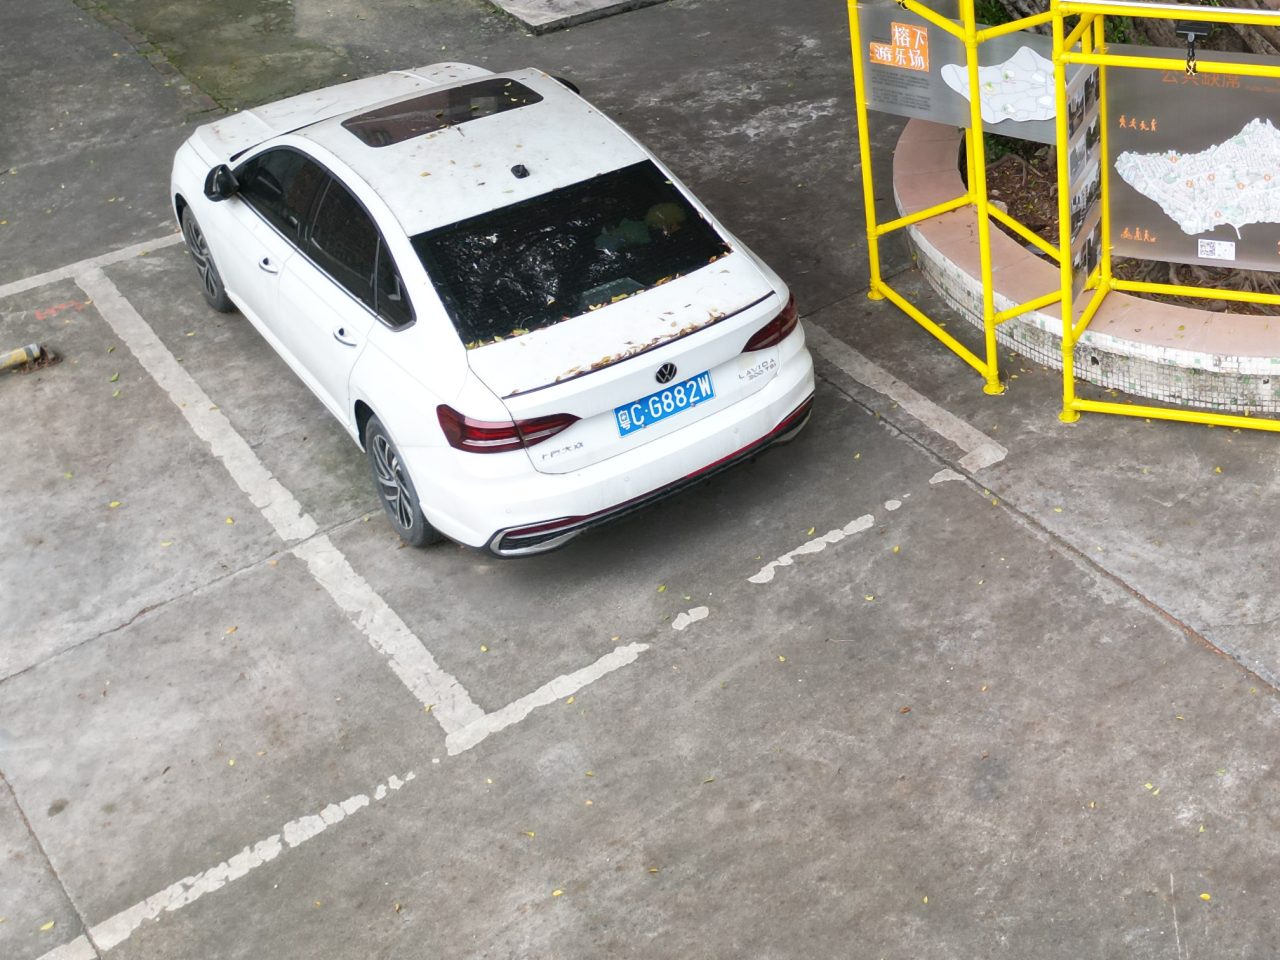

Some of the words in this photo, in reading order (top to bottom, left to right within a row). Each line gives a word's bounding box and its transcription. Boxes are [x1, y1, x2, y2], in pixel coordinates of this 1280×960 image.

[894, 25, 927, 49] 榕下
[874, 46, 925, 70] 游乐场
